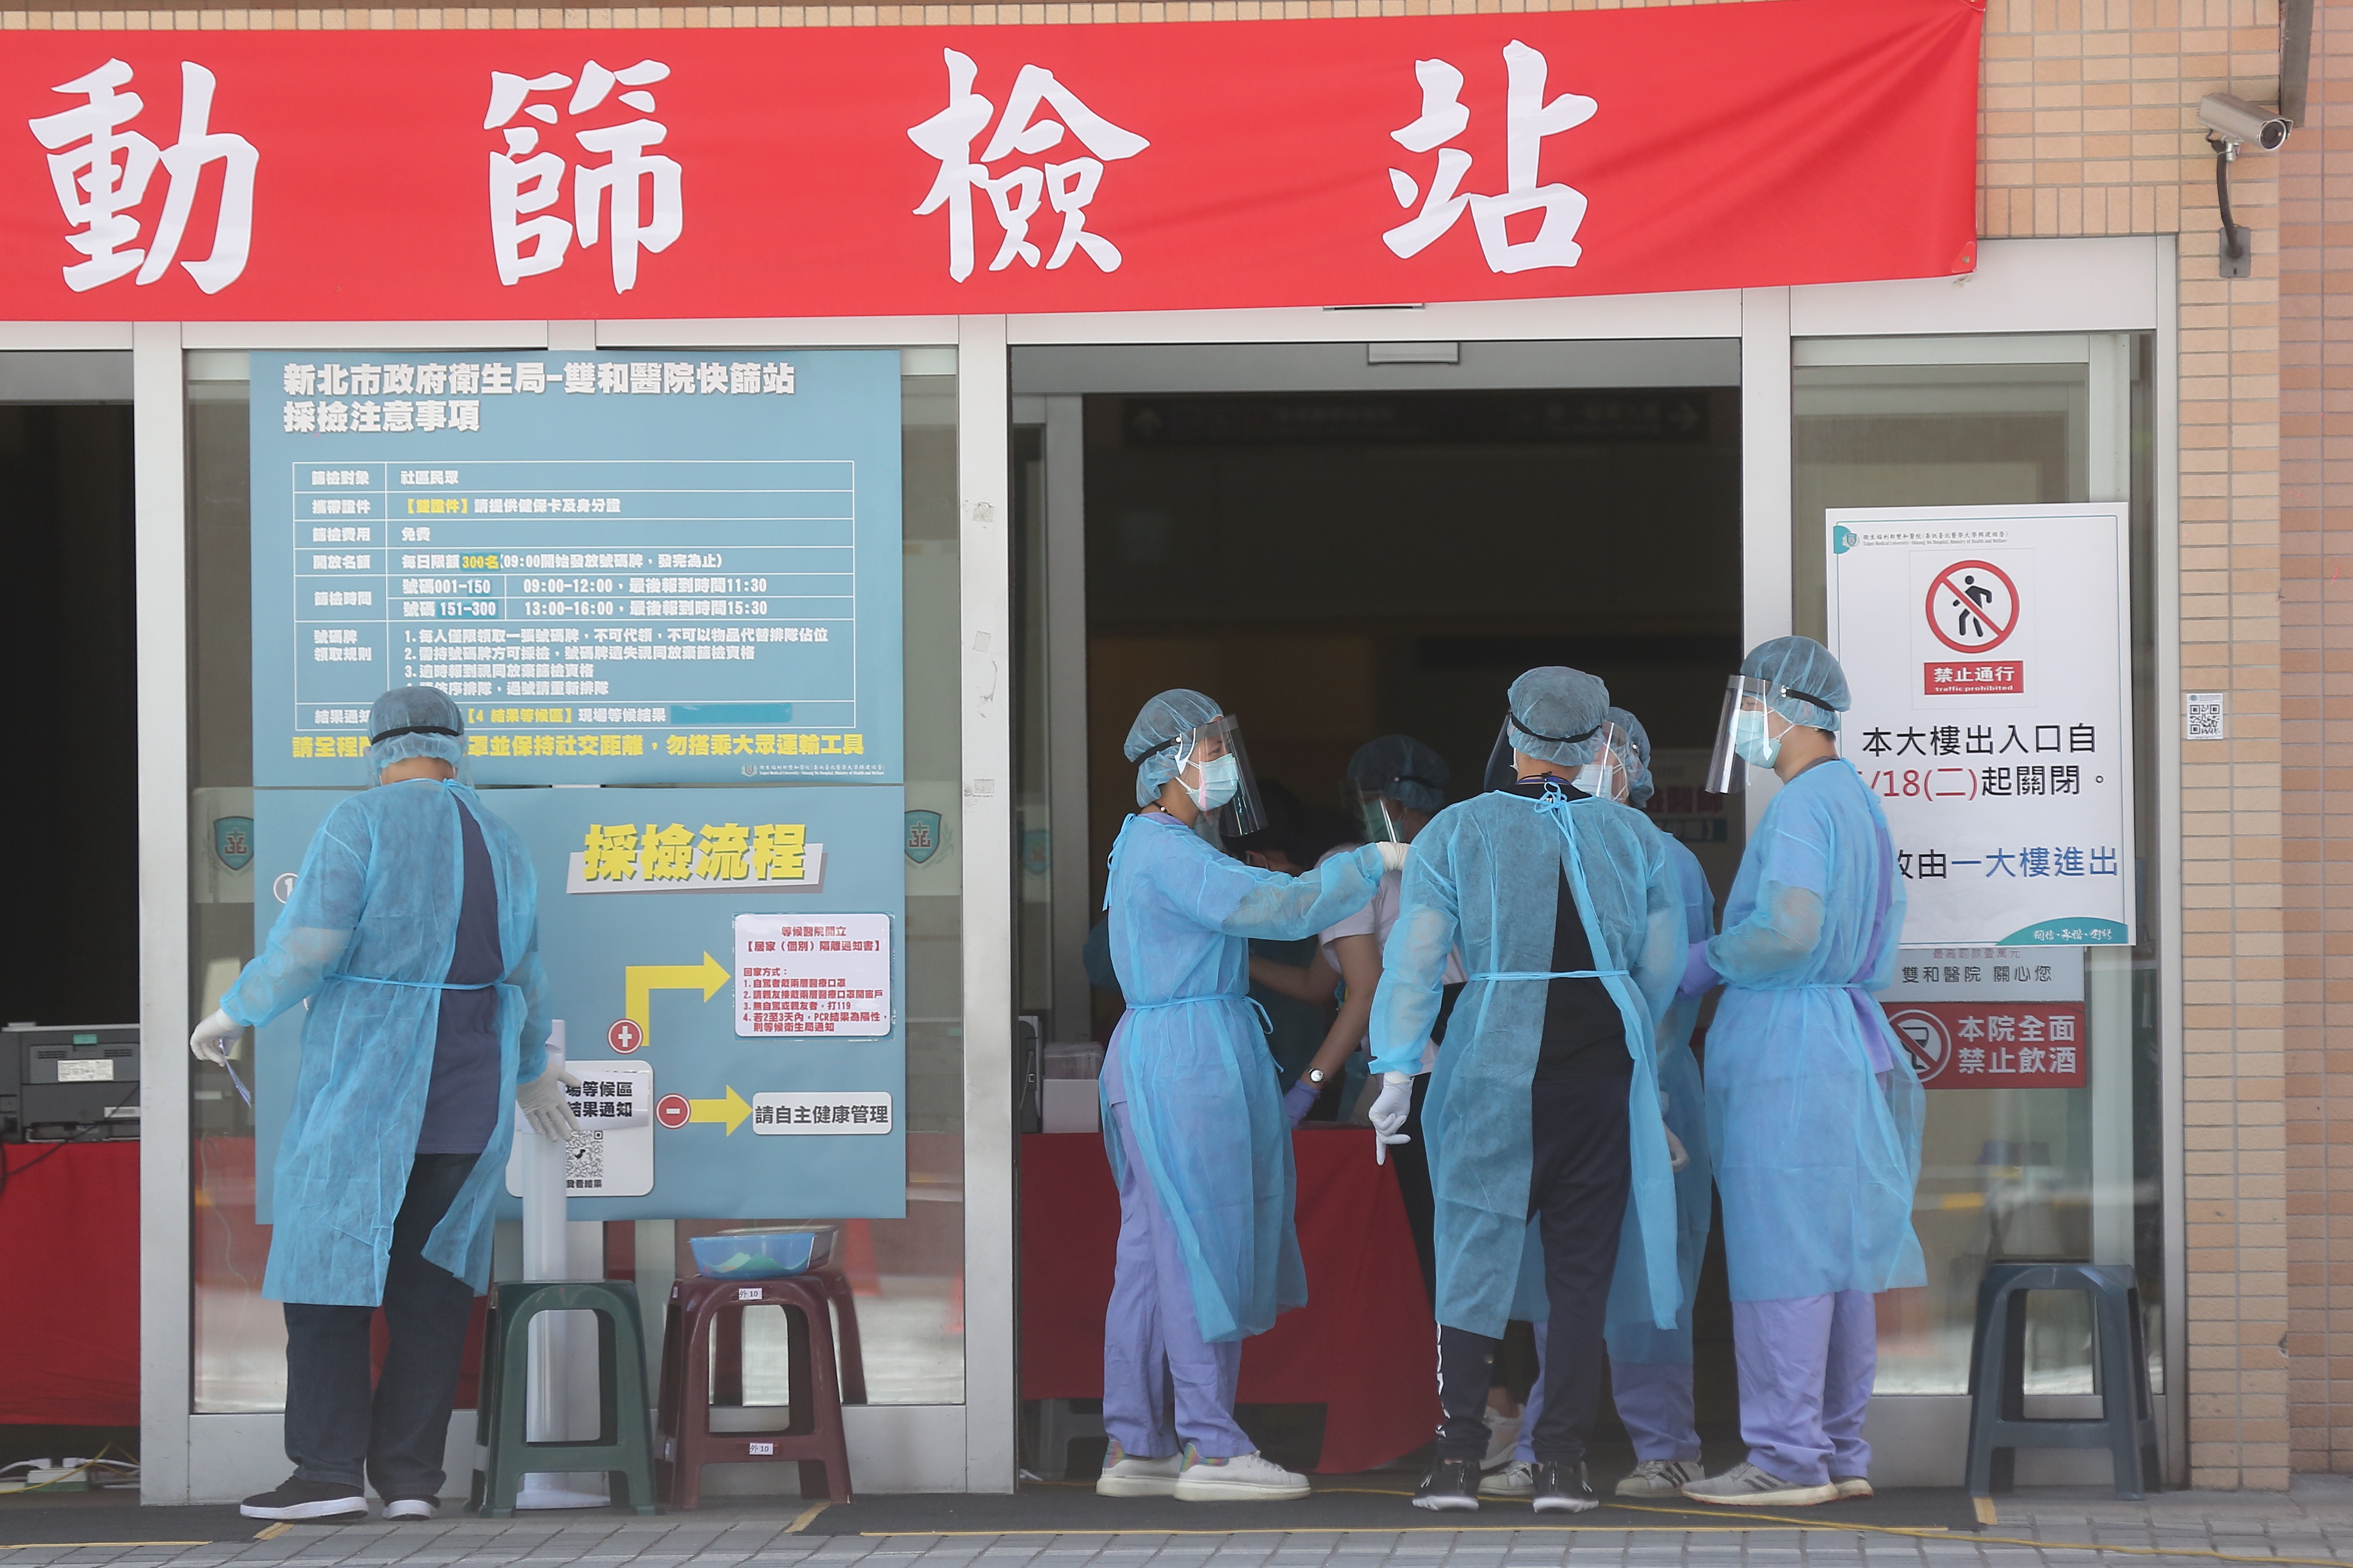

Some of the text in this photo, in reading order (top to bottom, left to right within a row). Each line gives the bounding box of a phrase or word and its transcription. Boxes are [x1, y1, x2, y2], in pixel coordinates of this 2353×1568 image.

[28, 39, 1598, 295] 動篩檢站
[284, 361, 795, 396] 新北市政府衛生局-雙和醫院快篩站
[284, 400, 480, 434] 採檢注意事項
[312, 470, 369, 485] 篩檢對象
[313, 527, 370, 542] 篩檢費用
[401, 527, 430, 541] 免費
[313, 555, 370, 569] 開放名額
[315, 591, 371, 605] 篩檢時間
[314, 647, 371, 661] 領取規則
[1934, 666, 2014, 682] 禁止通行
[1863, 723, 2094, 757] 本大樓出入口自
[1858, 765, 2104, 801] /18(二)起關閉。
[583, 822, 806, 882] 採檢流程
[782, 926, 846, 937] 等候醫院開立
[1903, 966, 2051, 983] 雙和醫院 關心您
[1958, 1015, 2075, 1042] 本院全面
[1959, 1047, 2076, 1073] 禁止飲酒
[755, 1105, 888, 1124] 請自主健康管理
